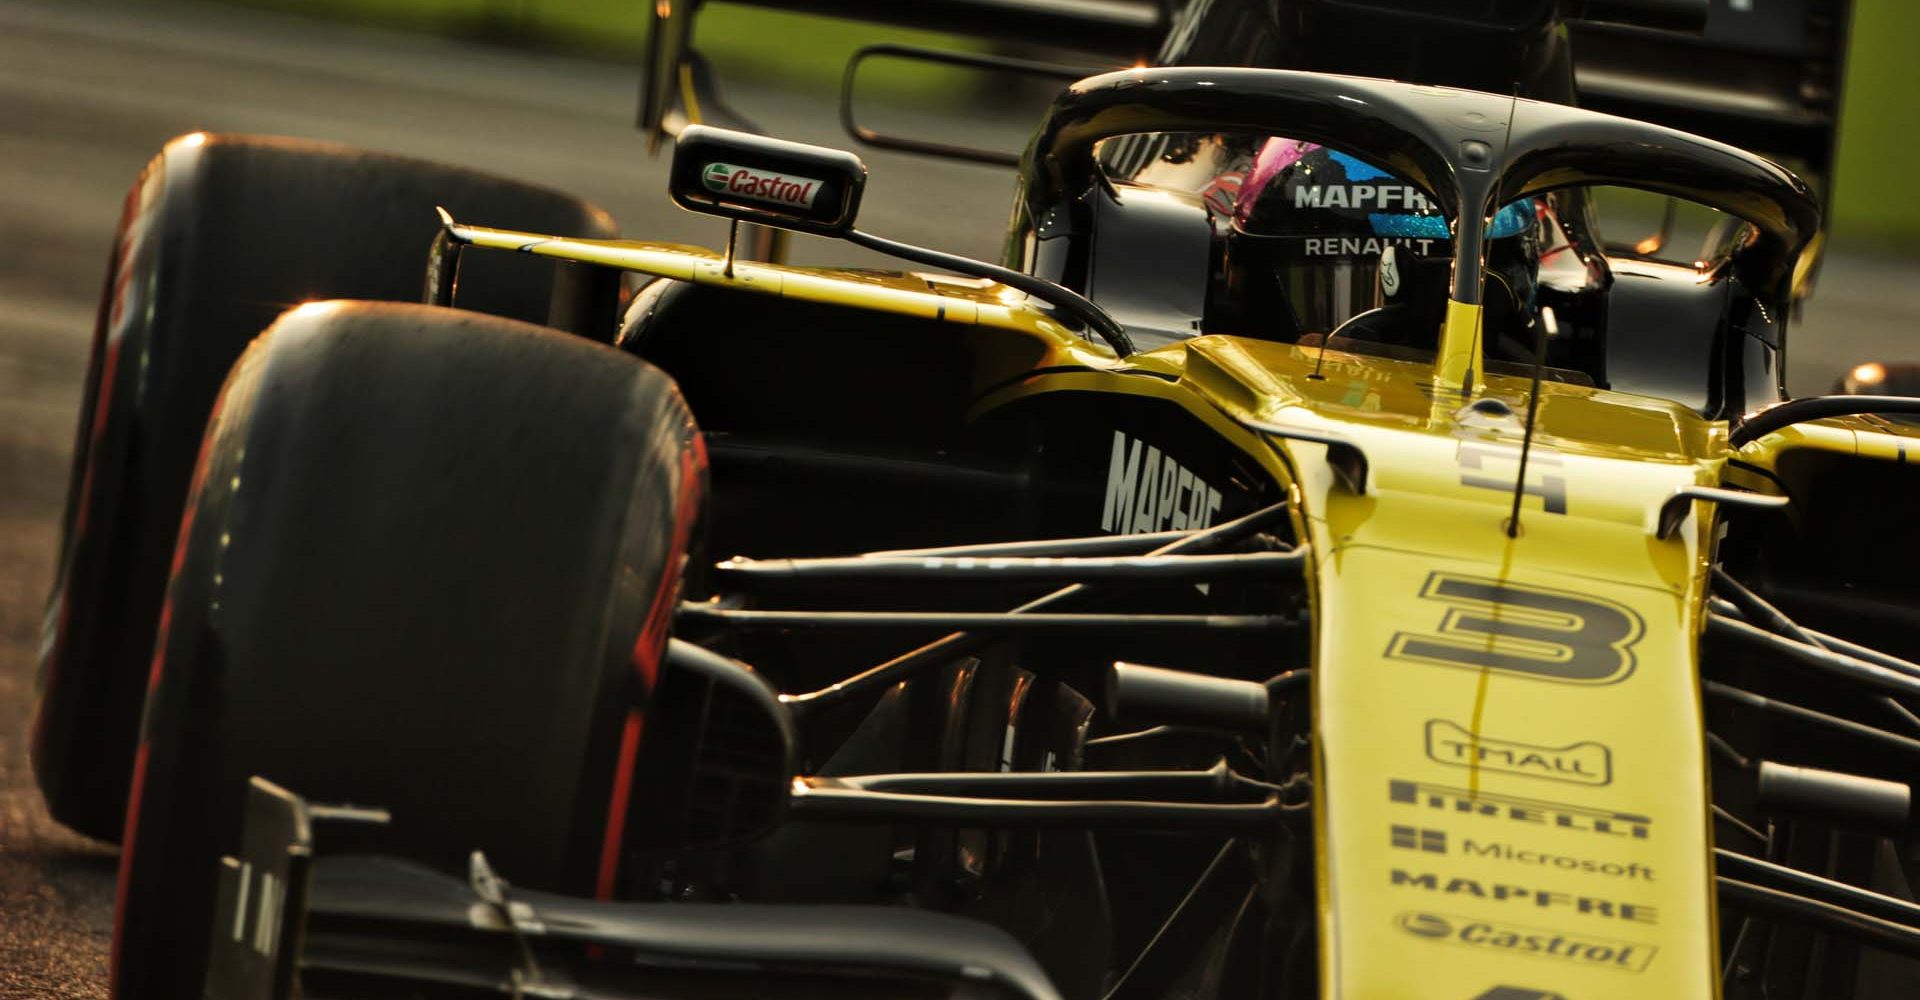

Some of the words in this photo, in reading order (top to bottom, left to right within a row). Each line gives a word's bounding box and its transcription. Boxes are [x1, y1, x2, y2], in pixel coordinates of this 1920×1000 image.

[728, 170, 814, 205] Castrol
[1295, 185, 1438, 209] MAPFR
[1383, 570, 1646, 687] 3
[1441, 739, 1597, 777] TMALL
[1462, 839, 1657, 881] Microsoft
[1389, 869, 1658, 925] MAPFRE
[1459, 922, 1635, 966] Castrol
